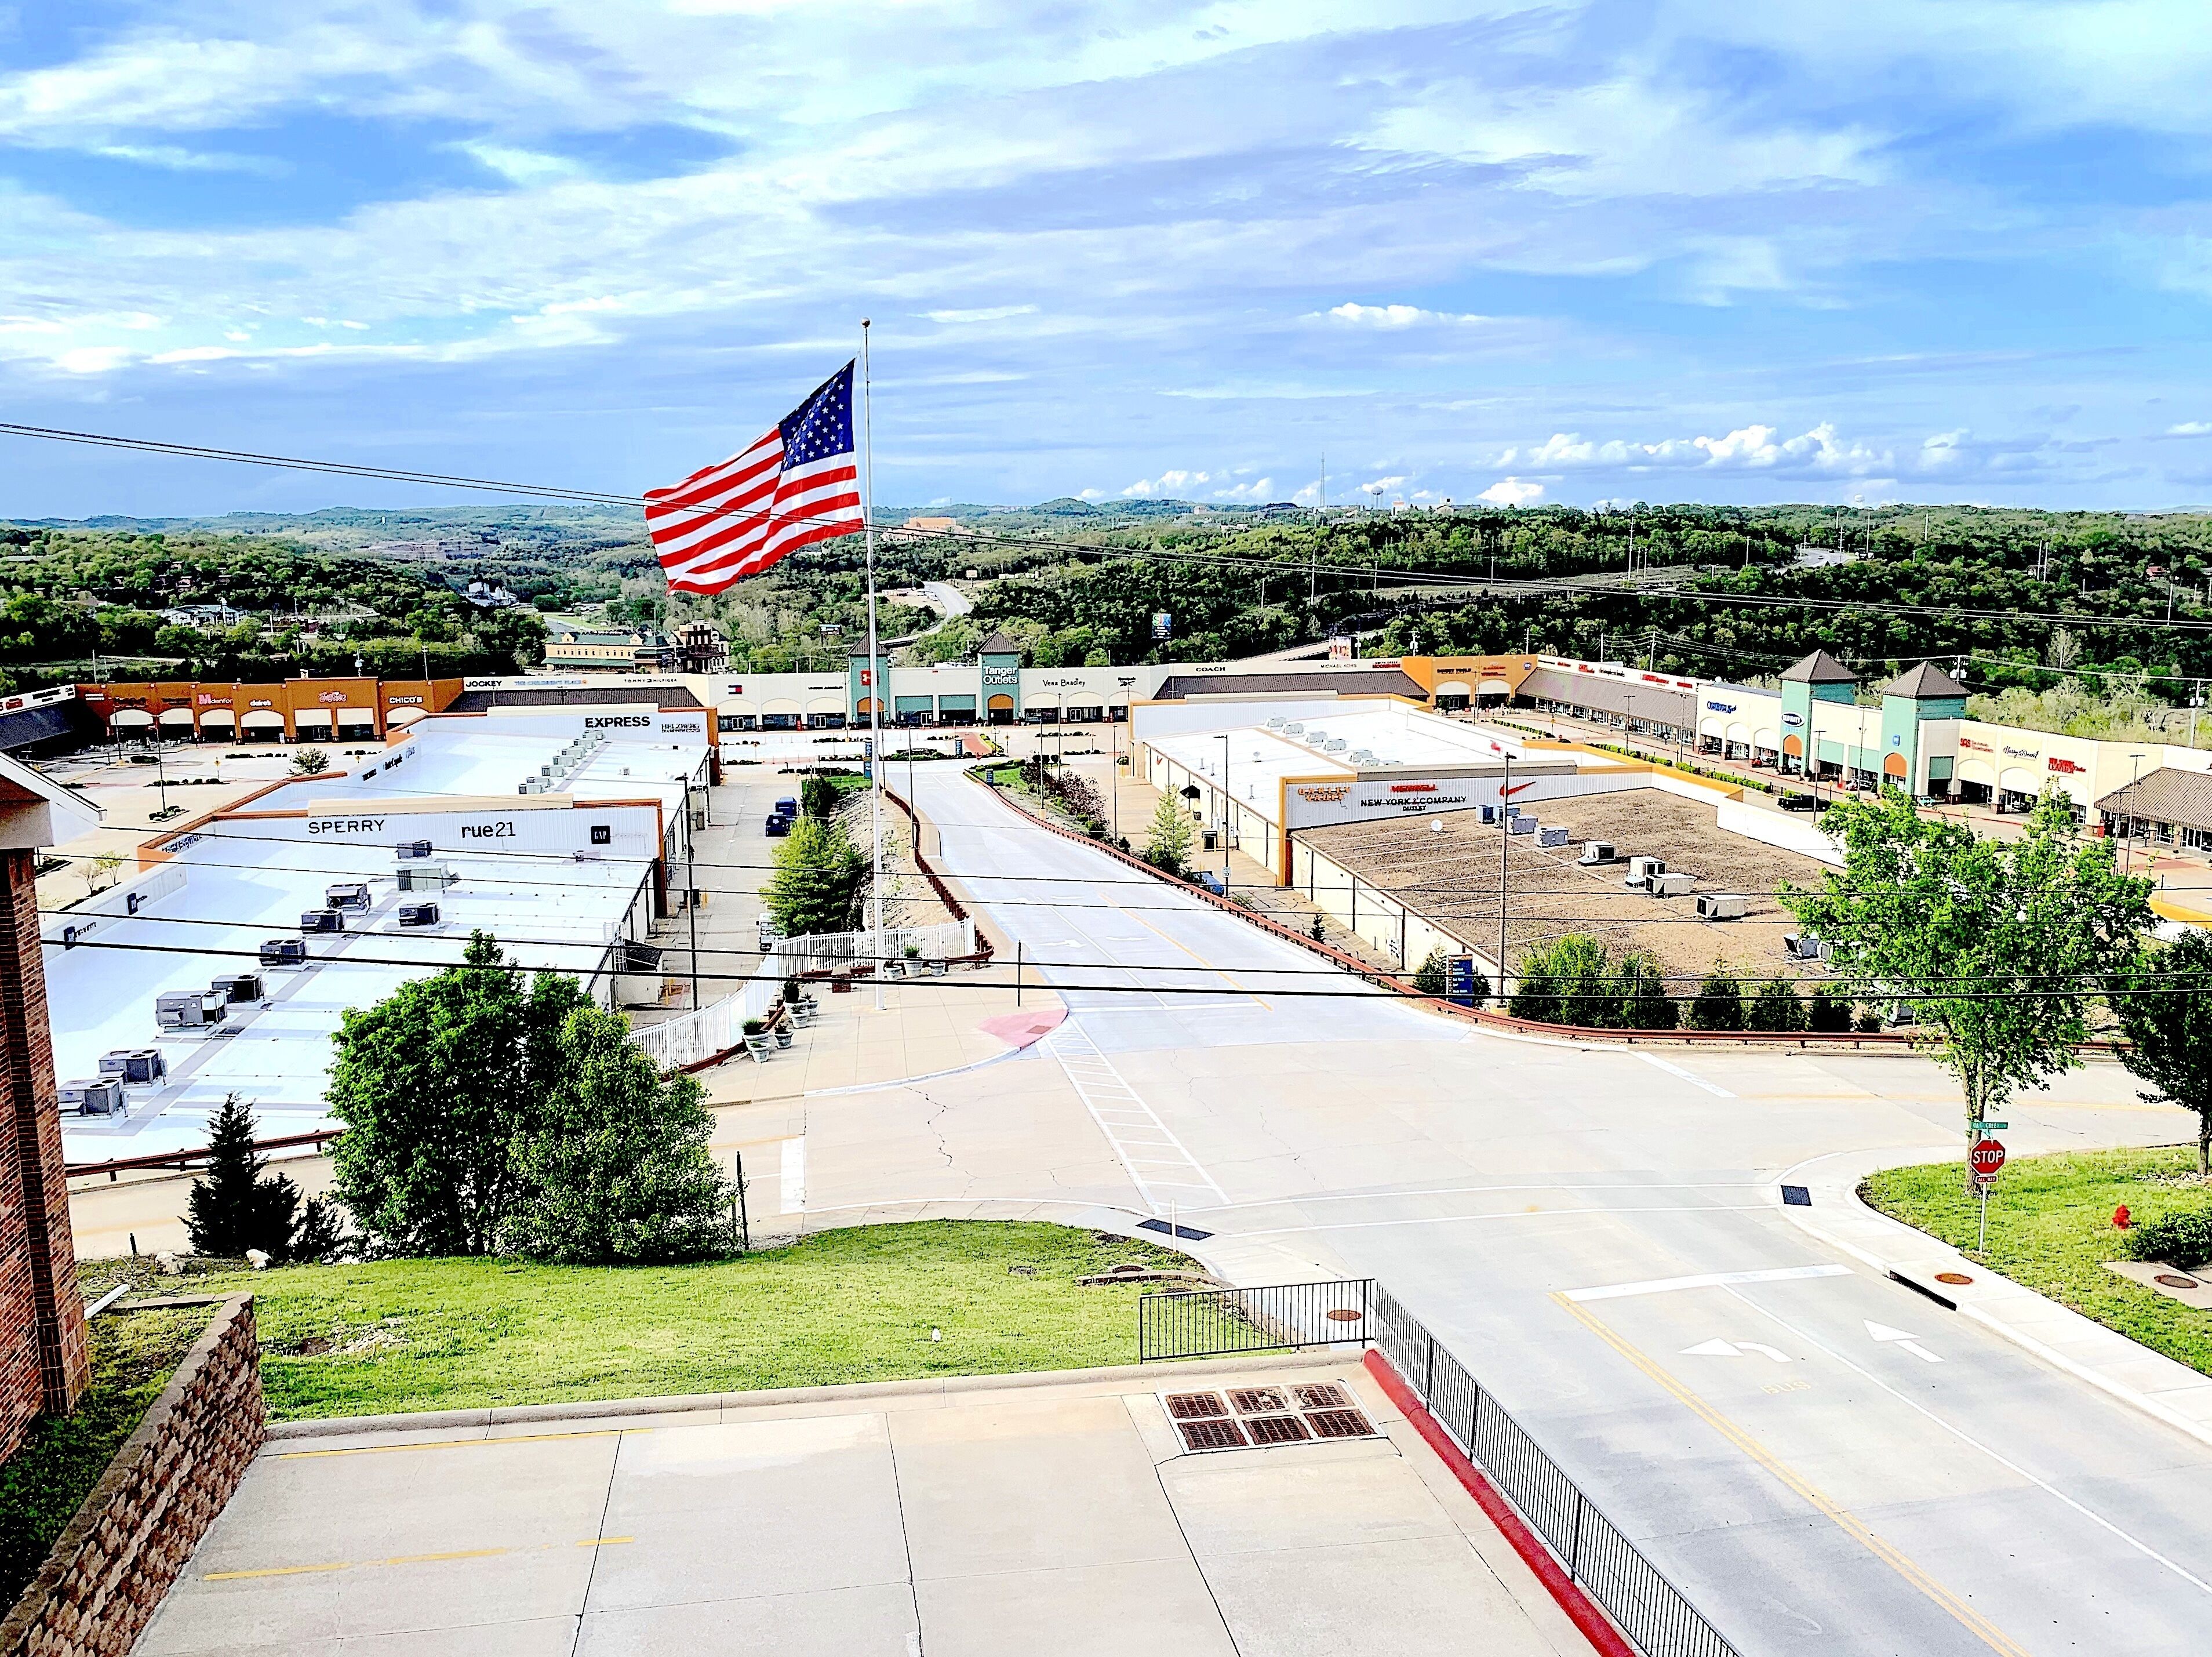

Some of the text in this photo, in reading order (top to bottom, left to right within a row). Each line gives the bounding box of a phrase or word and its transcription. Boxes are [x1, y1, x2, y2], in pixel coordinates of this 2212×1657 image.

[983, 666, 1017, 676] Tanger
[983, 675, 1018, 684] Outlets
[1061, 678, 1085, 687] Bradley
[585, 716, 650, 728] EXPRESS
[1360, 799, 1382, 807] NEW
[1384, 798, 1410, 806] YORK
[1420, 796, 1467, 805] COMPANY
[308, 819, 385, 834] SPERRY
[461, 821, 516, 838] rue21
[594, 831, 607, 840] GAP
[1973, 1150, 2004, 1164] STOP
